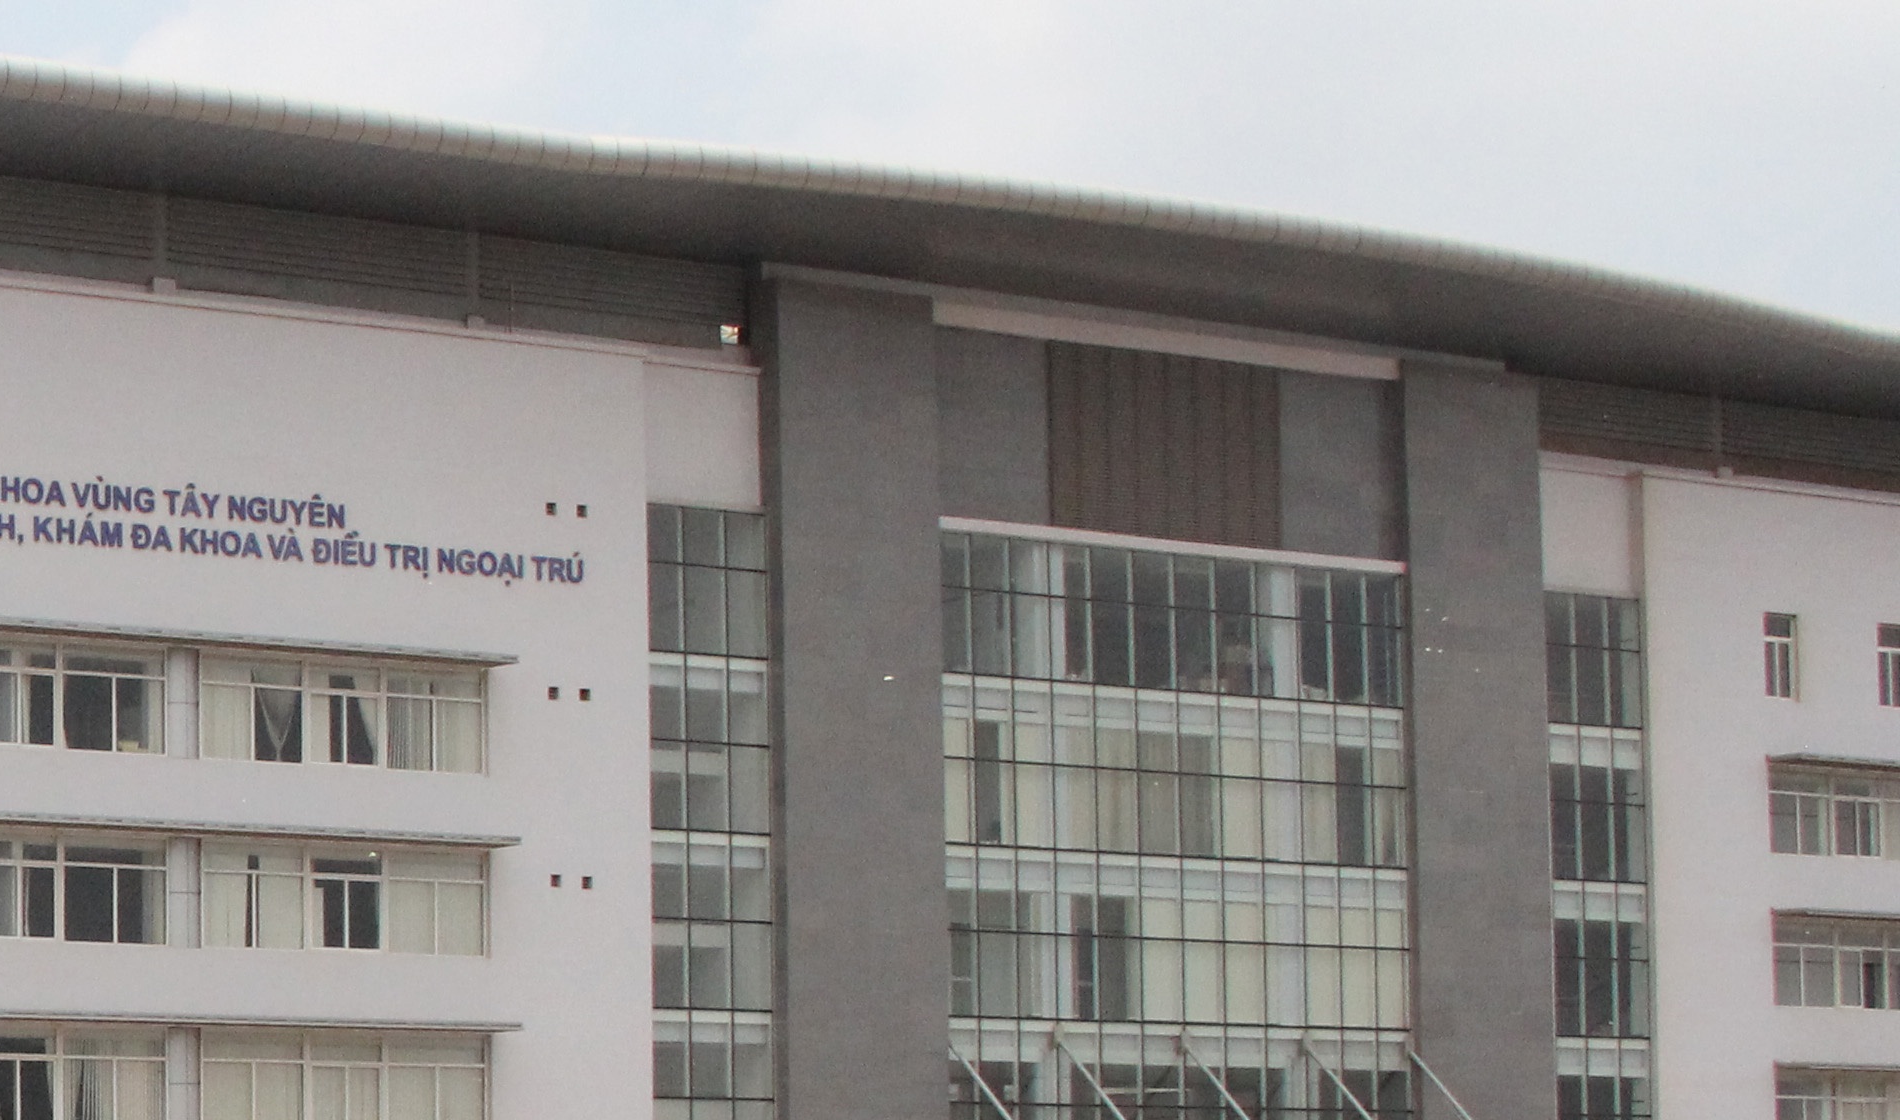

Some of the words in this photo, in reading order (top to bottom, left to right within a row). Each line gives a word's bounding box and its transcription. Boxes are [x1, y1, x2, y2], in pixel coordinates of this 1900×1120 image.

[71, 475, 155, 513] VÙNG
[163, 482, 220, 519] TÂY
[228, 494, 346, 529] NGUYÊN
[33, 512, 123, 548] KHÁM
[130, 524, 173, 551] ĐA
[179, 527, 263, 558] KHOA
[267, 527, 304, 562] VÀ
[384, 543, 429, 579] TRỊ
[437, 547, 524, 587] NGOẠI
[530, 551, 585, 584] TRÚ
